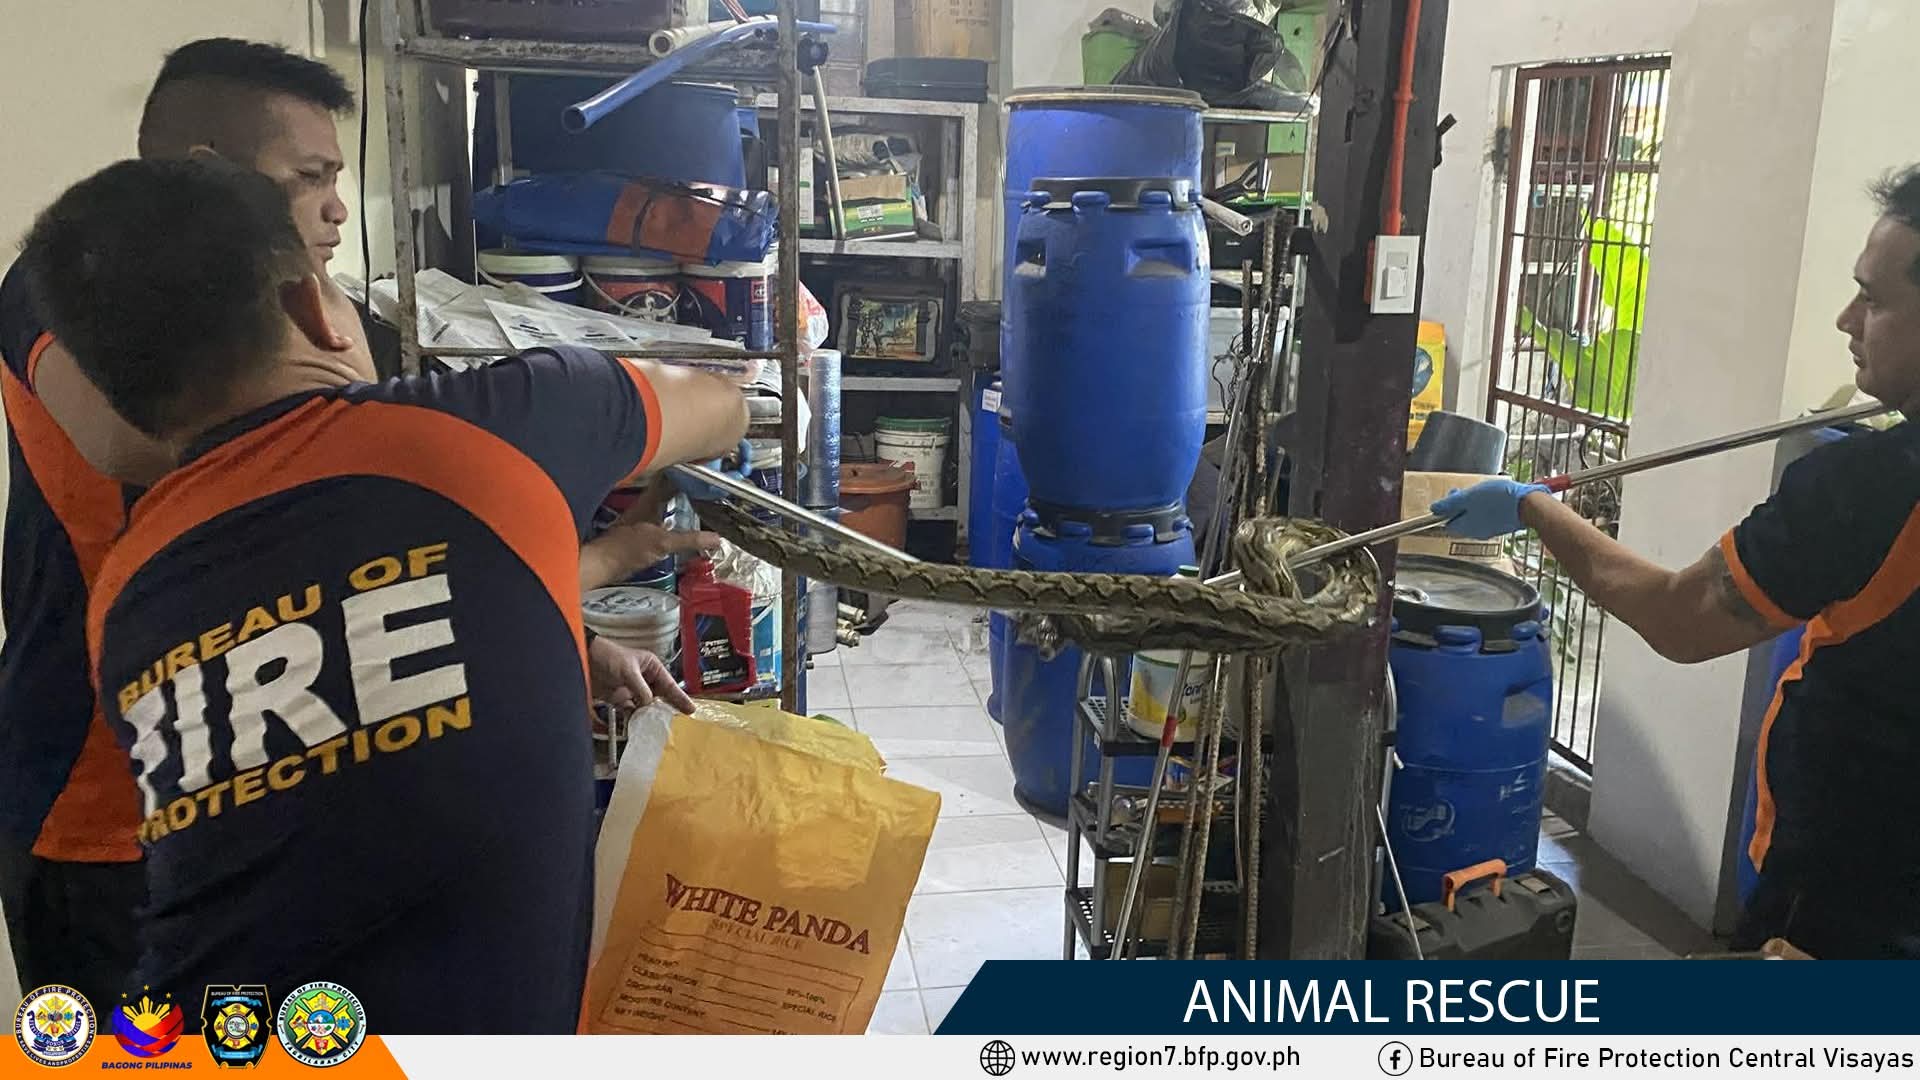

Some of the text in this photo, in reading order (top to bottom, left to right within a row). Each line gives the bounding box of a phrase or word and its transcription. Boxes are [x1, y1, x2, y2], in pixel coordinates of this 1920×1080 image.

[118, 543, 448, 713] BUREAU OF
[122, 575, 468, 817] FIRE
[665, 873, 870, 955] WHITE PANDA
